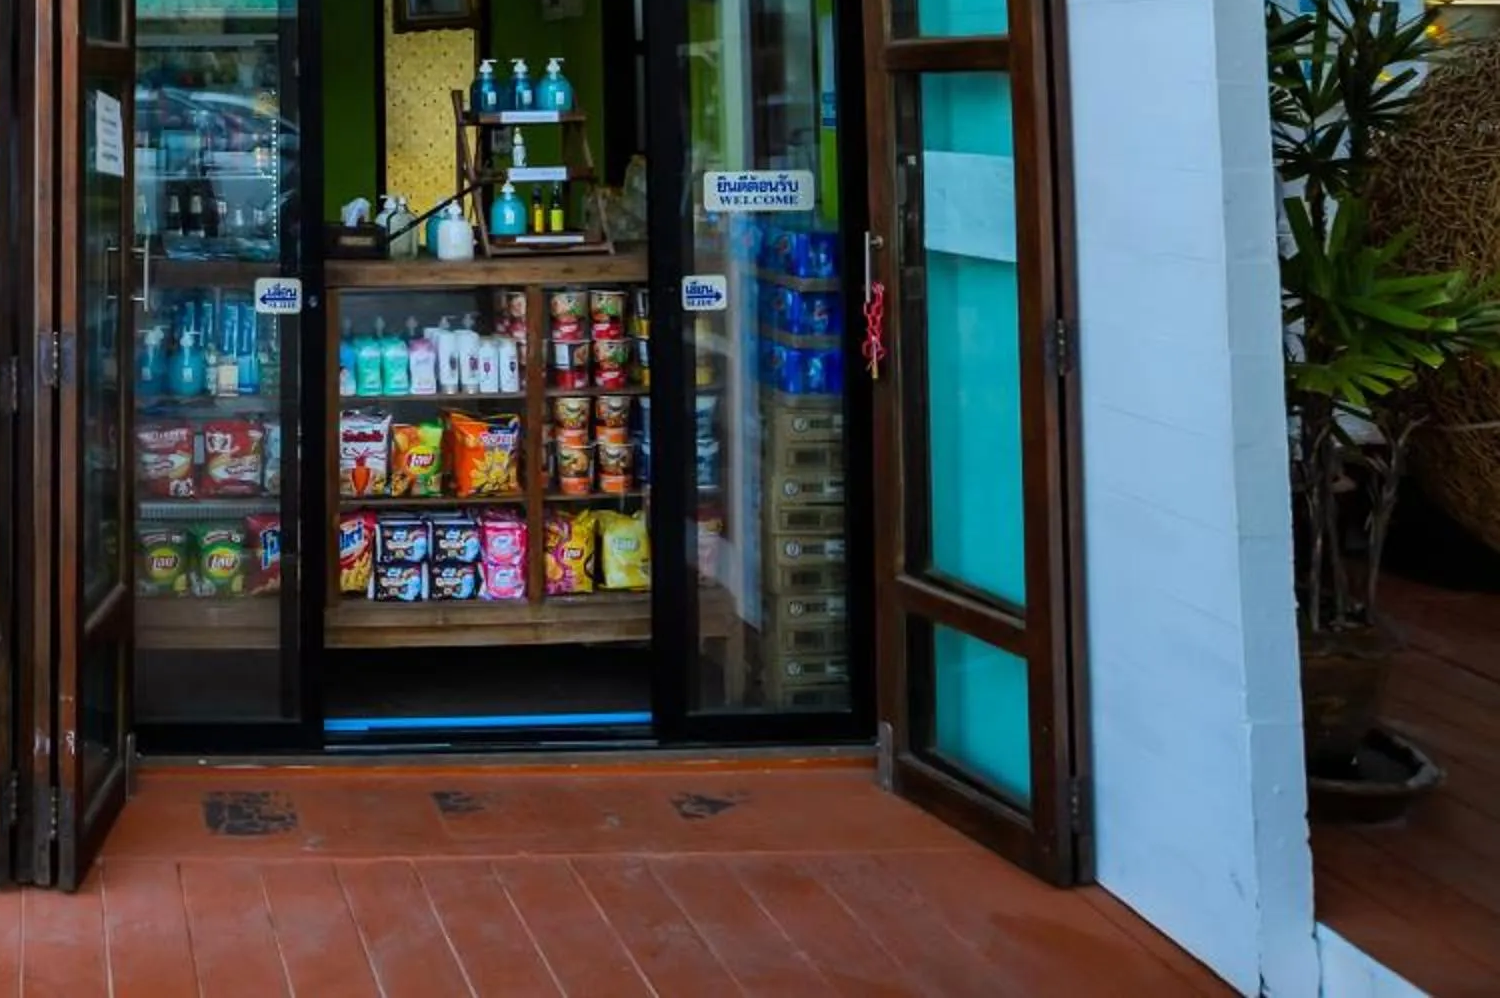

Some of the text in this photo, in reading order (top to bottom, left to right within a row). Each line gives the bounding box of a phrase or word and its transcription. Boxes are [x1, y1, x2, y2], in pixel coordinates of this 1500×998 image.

[717, 174, 799, 193] ยินดีต้อนรับ
[720, 195, 799, 205] WELCOME
